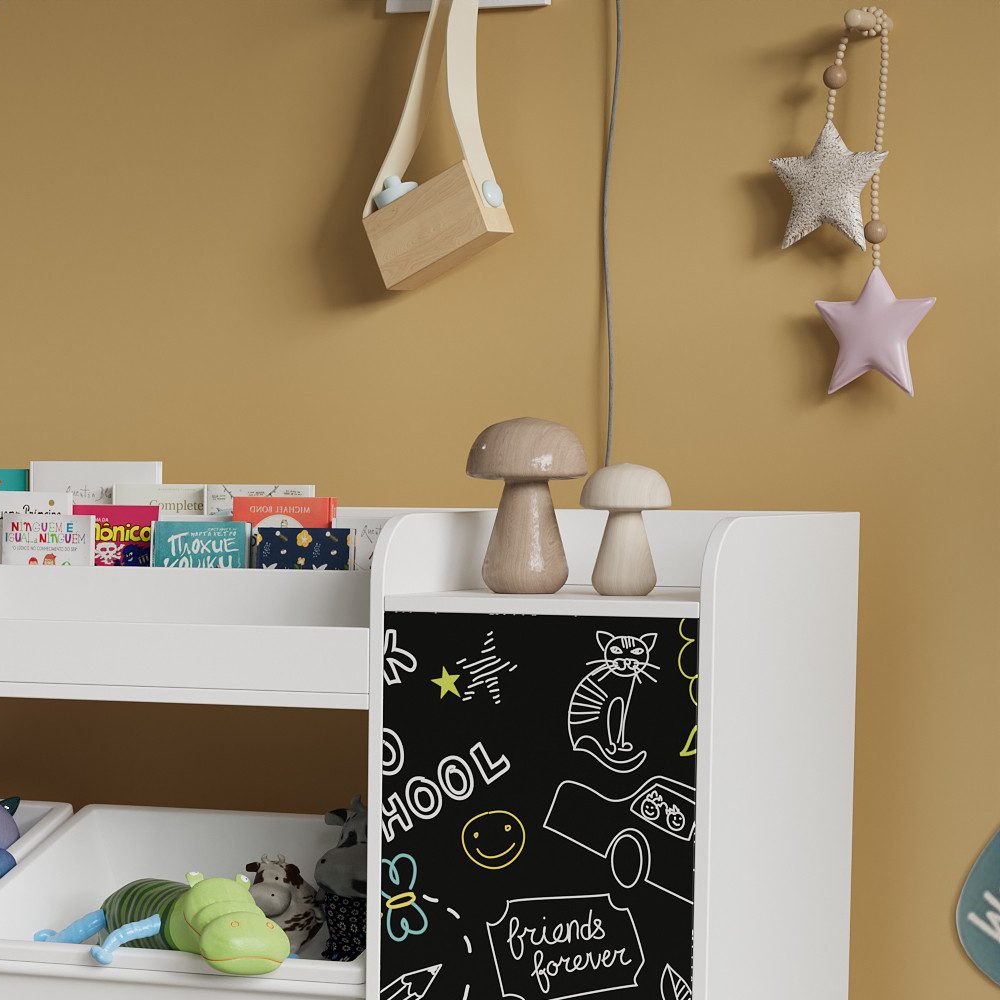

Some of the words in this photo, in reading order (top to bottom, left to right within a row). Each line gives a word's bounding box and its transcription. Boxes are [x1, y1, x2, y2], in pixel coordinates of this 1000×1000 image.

[149, 499, 204, 515] Complete
[507, 909, 606, 960] friends
[531, 947, 633, 994] forever
